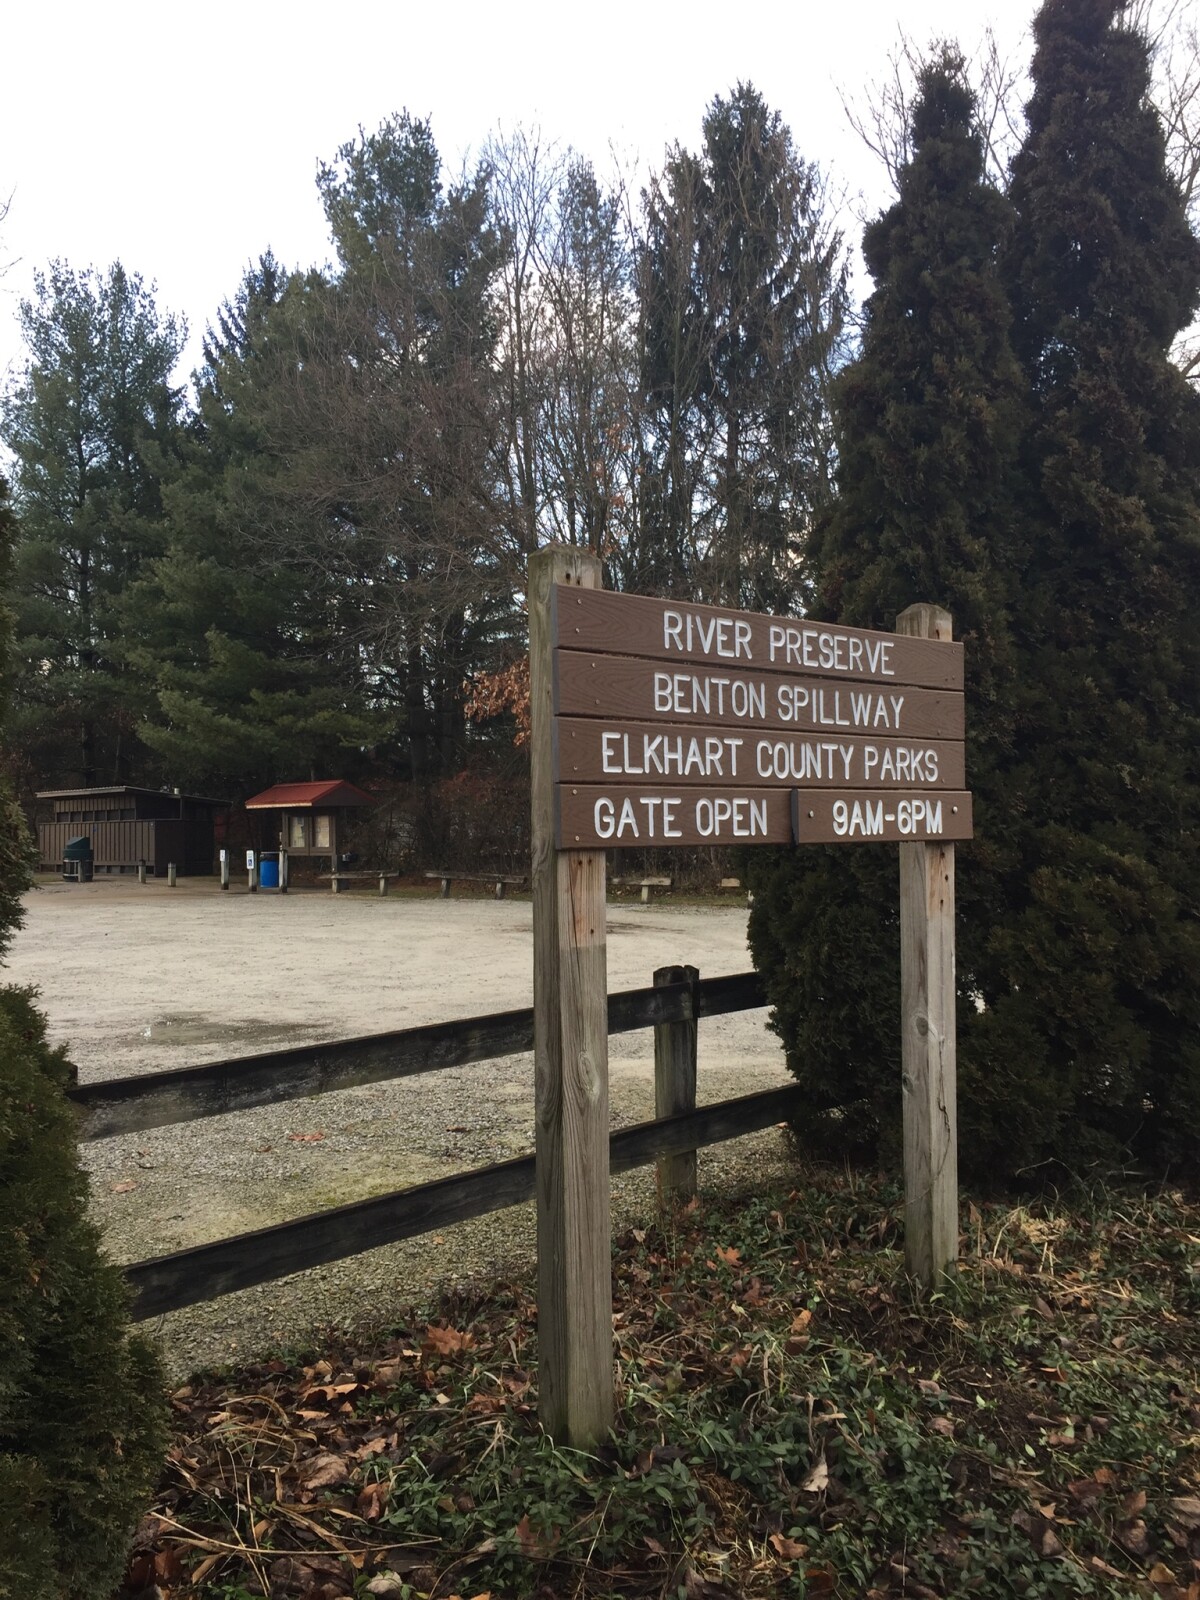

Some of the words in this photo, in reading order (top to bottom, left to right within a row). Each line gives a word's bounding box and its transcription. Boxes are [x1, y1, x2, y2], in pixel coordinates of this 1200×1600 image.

[663, 609, 753, 659] RIVER
[769, 625, 895, 676] PRESERVE
[654, 672, 766, 719] BENTON
[777, 684, 904, 729] SPILLWAY
[601, 731, 743, 776] ELKHART
[756, 740, 854, 780] COUNTY
[864, 745, 939, 782] PARKS
[594, 797, 683, 839] GATE
[695, 798, 768, 837] OPEN
[832, 799, 943, 836] 9AM-6PM
